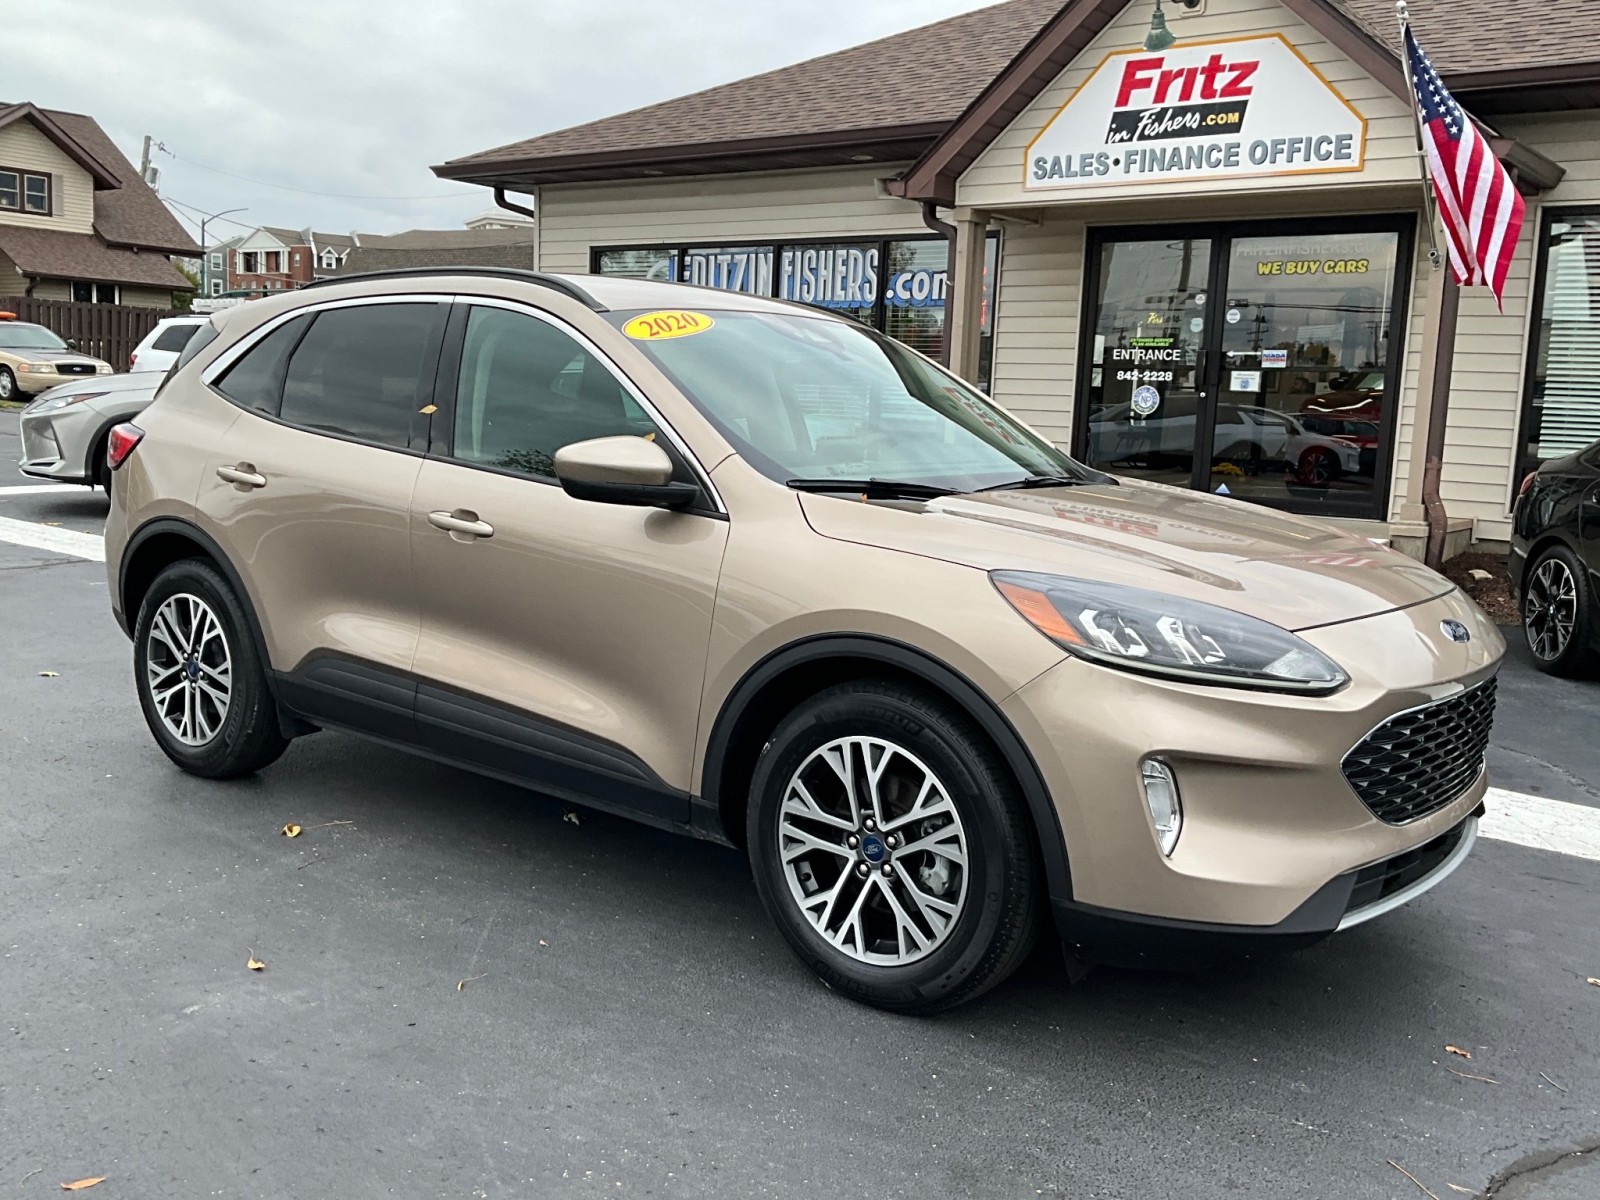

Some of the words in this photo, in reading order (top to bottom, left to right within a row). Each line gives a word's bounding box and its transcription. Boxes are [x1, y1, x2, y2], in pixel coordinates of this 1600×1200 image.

[1115, 54, 1260, 108] Fritz
[1107, 122, 1132, 143] in
[1032, 152, 1110, 180] SALES
[1123, 142, 1241, 173] FINANCE
[1248, 134, 1354, 165] OFFICE
[780, 248, 879, 303] FISHERS
[1257, 260, 1283, 276] WE
[1285, 260, 1320, 275] BUY
[1323, 259, 1369, 274] CARS
[639, 312, 699, 337] 2020
[1112, 348, 1181, 361] ENTRANCE
[1116, 370, 1173, 381] 842-2228
